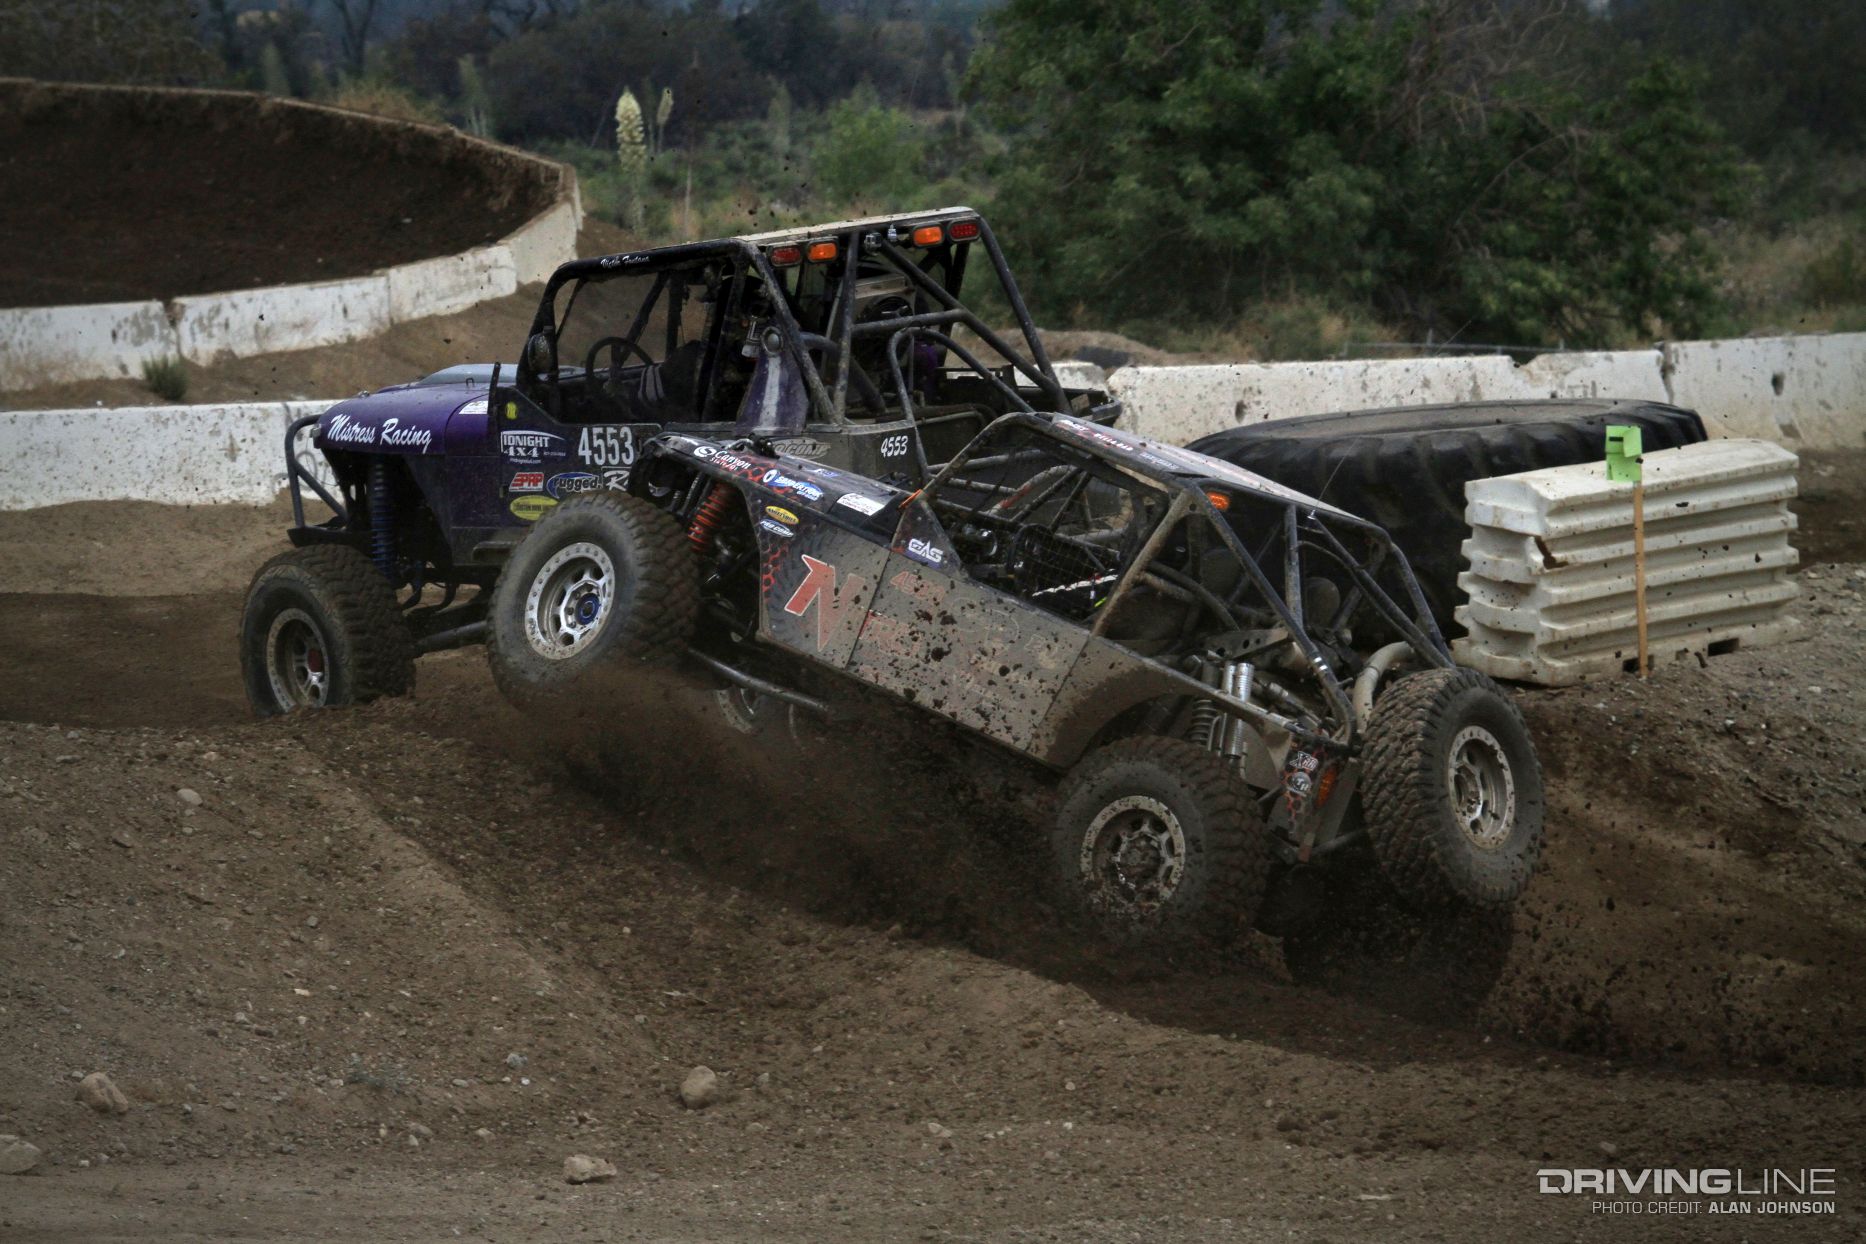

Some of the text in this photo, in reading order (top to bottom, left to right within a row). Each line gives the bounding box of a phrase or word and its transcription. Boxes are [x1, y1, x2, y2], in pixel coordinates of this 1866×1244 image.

[327, 414, 432, 454] Mistress Racing
[578, 426, 634, 466] 4553
[881, 436, 908, 457] 4553
[715, 451, 751, 469] Canyon
